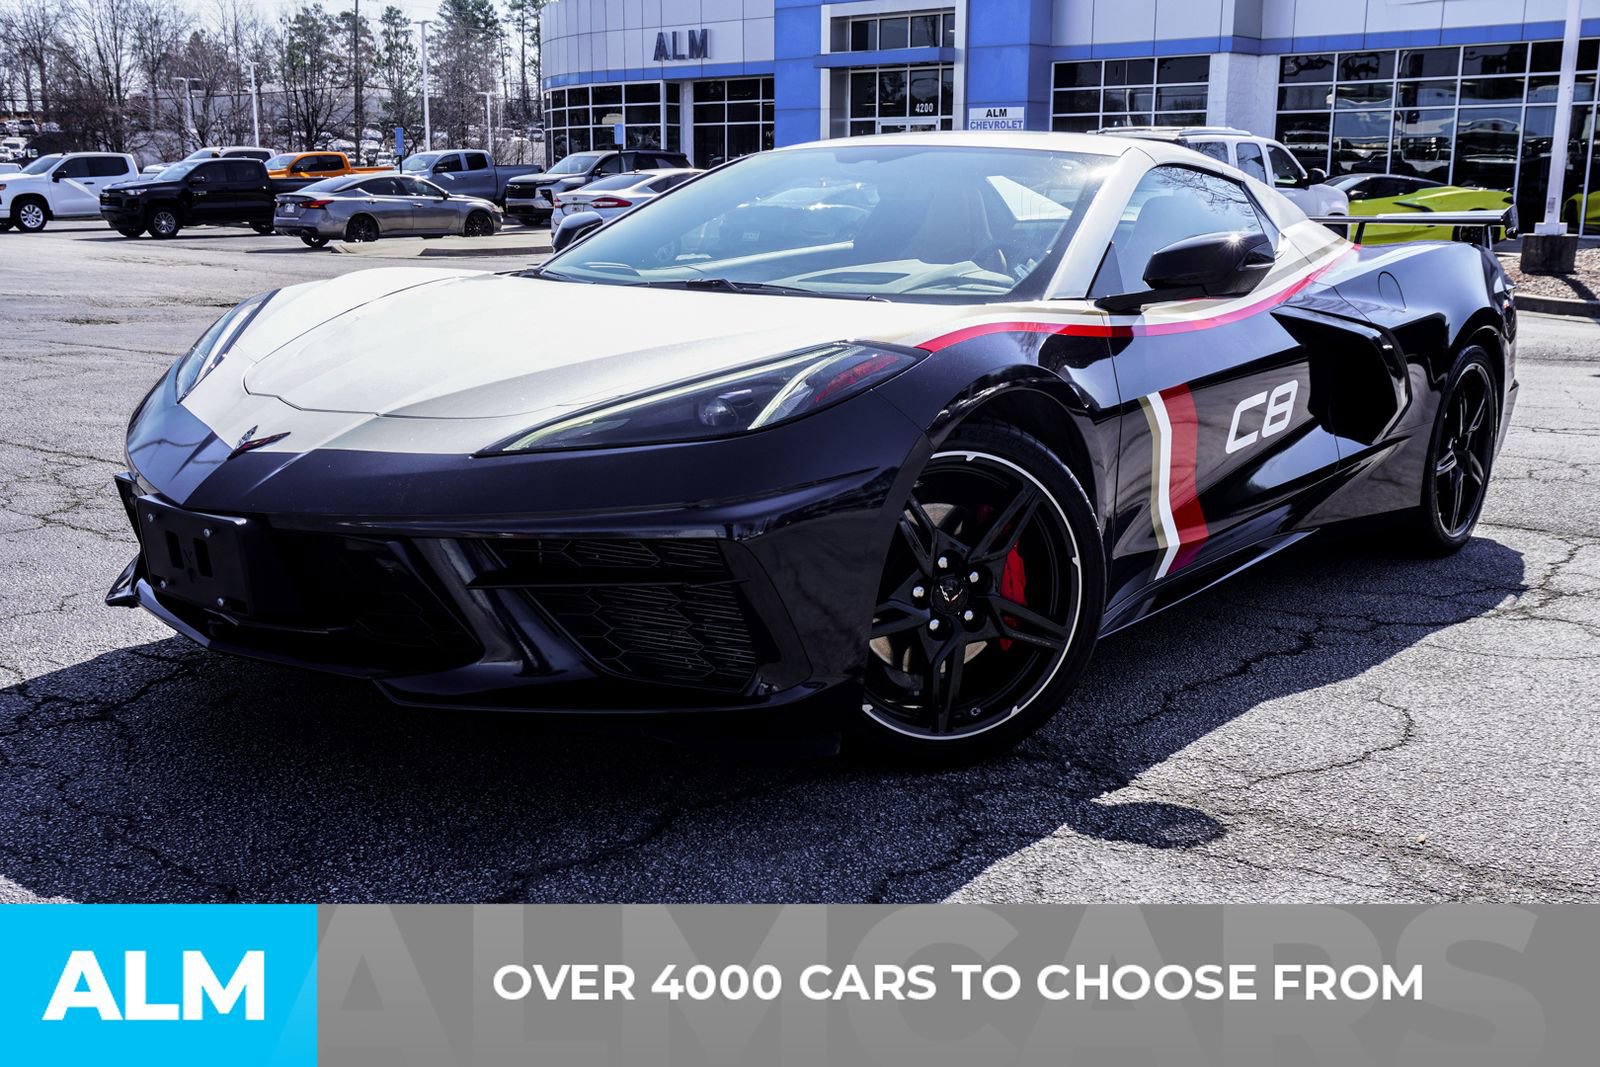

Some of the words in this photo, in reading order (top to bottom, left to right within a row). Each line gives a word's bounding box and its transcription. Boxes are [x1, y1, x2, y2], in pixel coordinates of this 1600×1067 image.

[653, 29, 709, 61] ALM
[915, 103, 933, 113] 4200
[986, 108, 1007, 118] ALM
[970, 120, 1023, 130] CHEVROLET
[1225, 380, 1299, 455] C8
